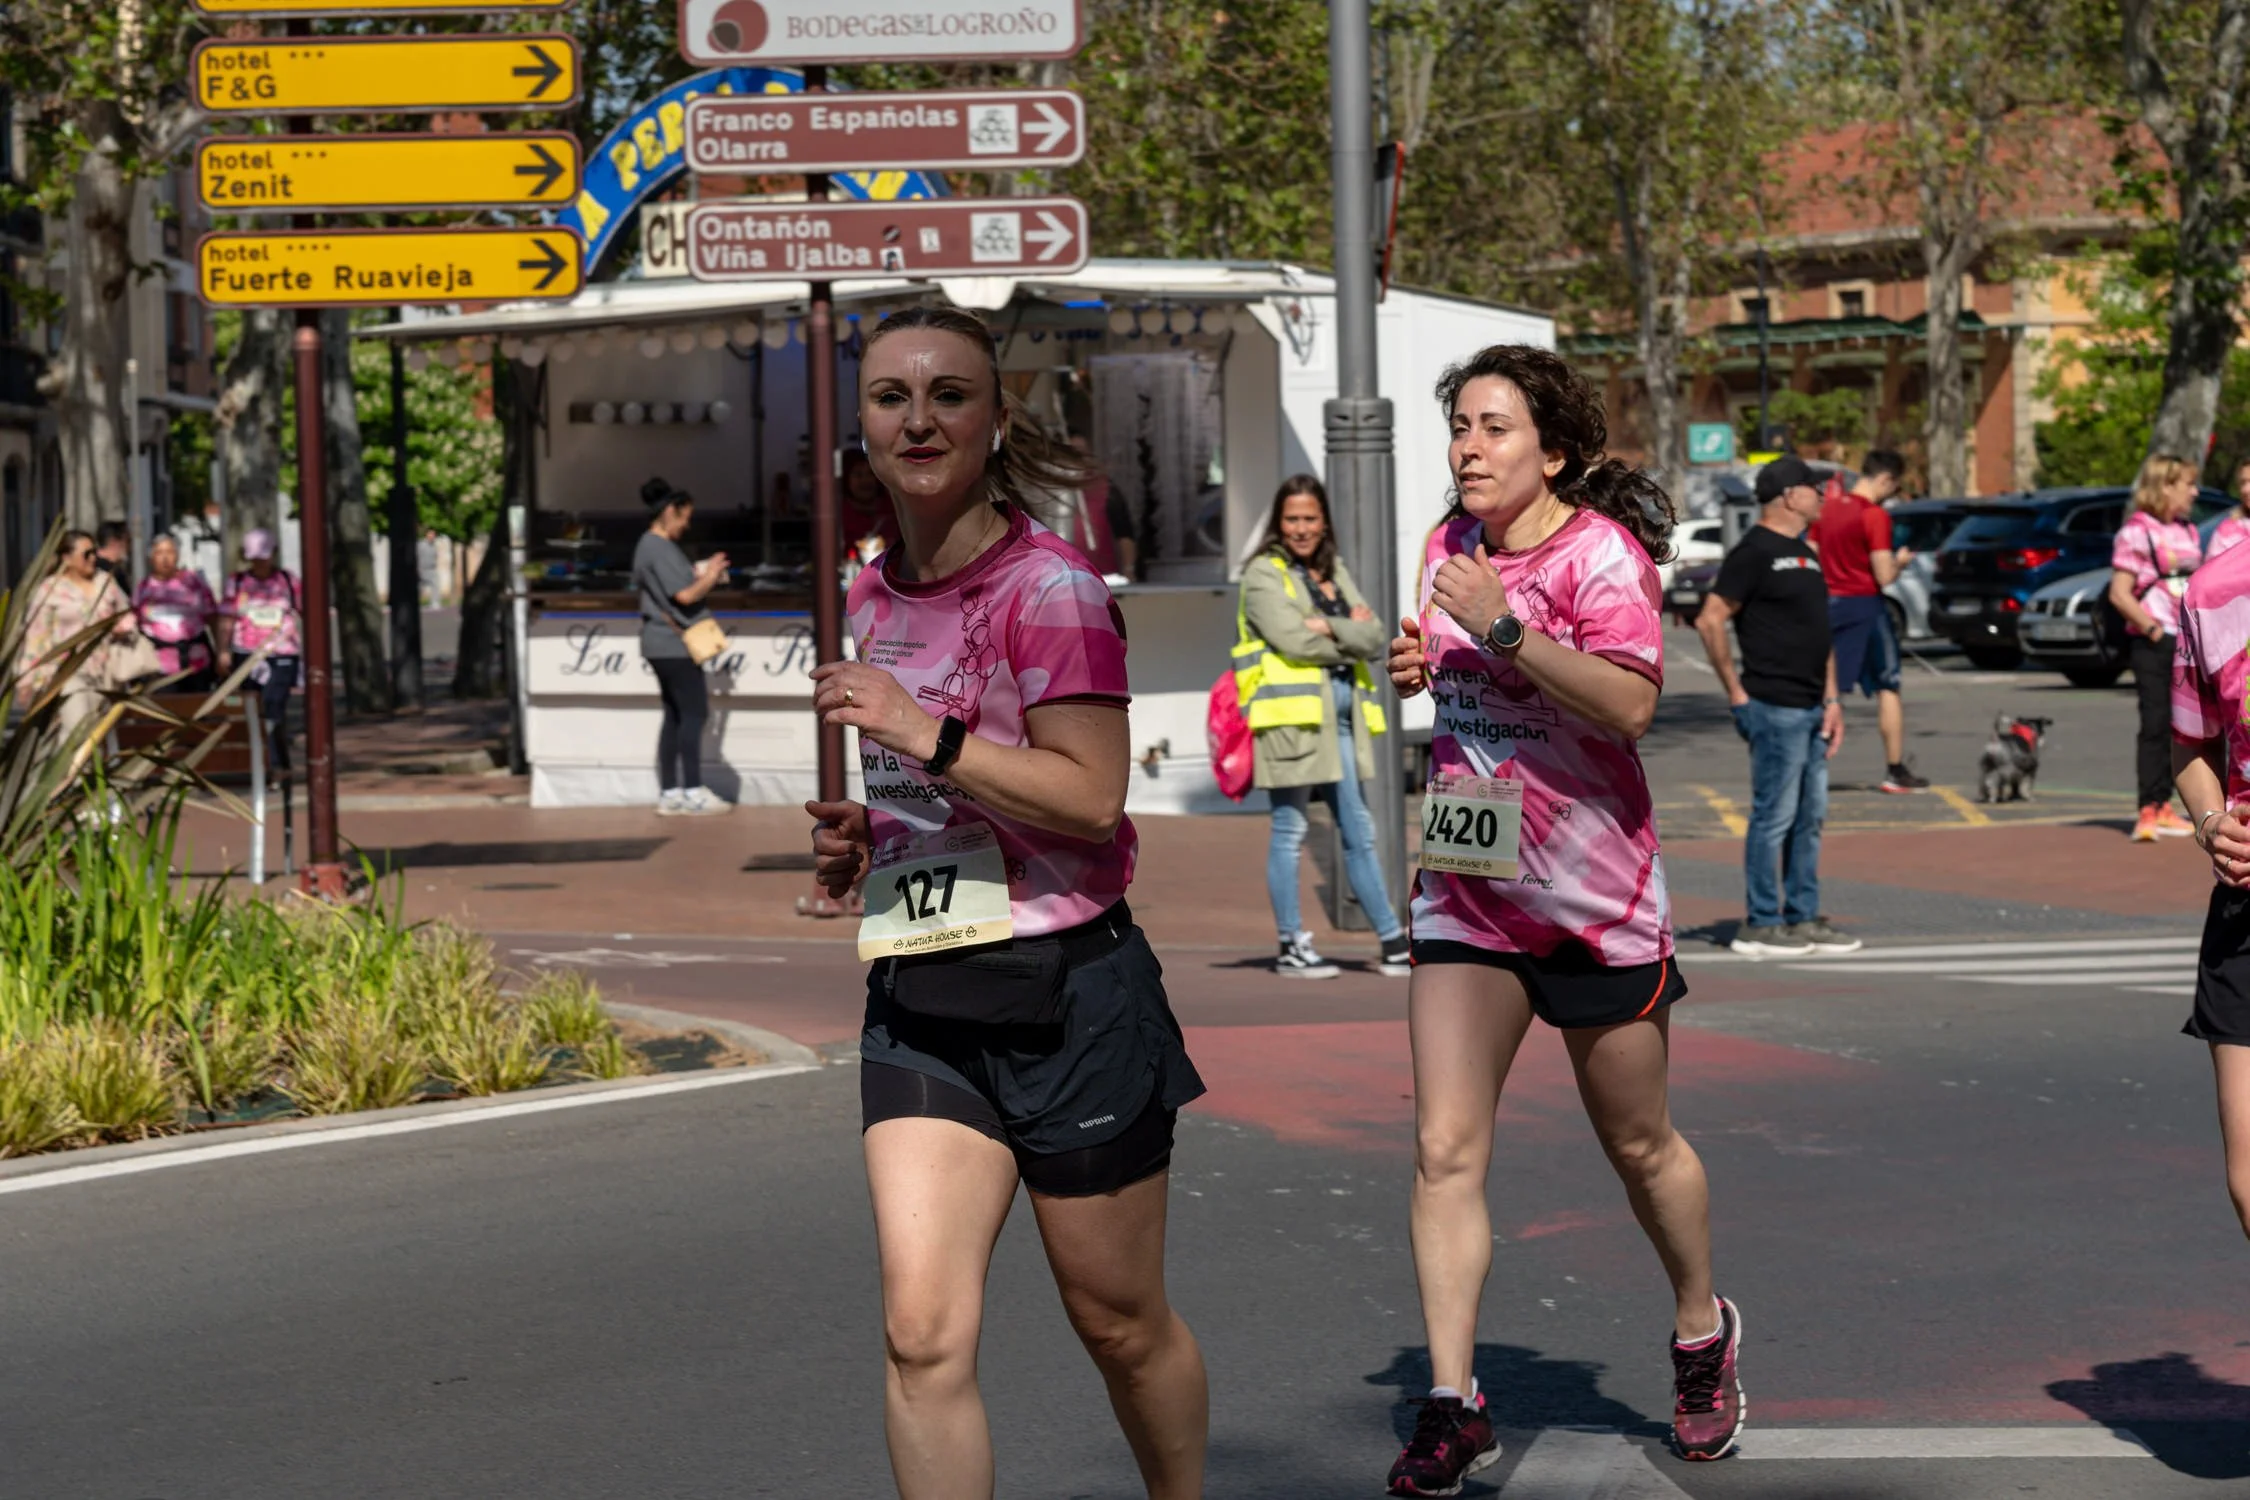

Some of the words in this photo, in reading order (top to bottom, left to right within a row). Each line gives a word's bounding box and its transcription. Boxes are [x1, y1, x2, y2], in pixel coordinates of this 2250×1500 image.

[926, 7, 1057, 36] LOGROÑO
[206, 50, 271, 70] hotel
[697, 109, 793, 132] Franco
[810, 104, 959, 134] Españolas
[208, 150, 273, 169] hotel
[698, 137, 788, 161] Olarra
[210, 174, 293, 198] Zenit
[700, 214, 831, 241] Ontañón
[209, 244, 269, 262] hotel
[702, 244, 767, 269] Viña
[786, 241, 872, 272] Ijalba
[210, 267, 312, 291] Fuerte
[334, 263, 474, 292] Ruavieja
[558, 623, 628, 676] La
[1458, 690, 1478, 710] la
[881, 749, 900, 772] la
[1425, 803, 1498, 848] 2420
[894, 864, 957, 922] 127
[905, 935, 934, 949] NATUR
[934, 930, 964, 943] HOUSE
[1078, 1114, 1115, 1129] KIPRUN
